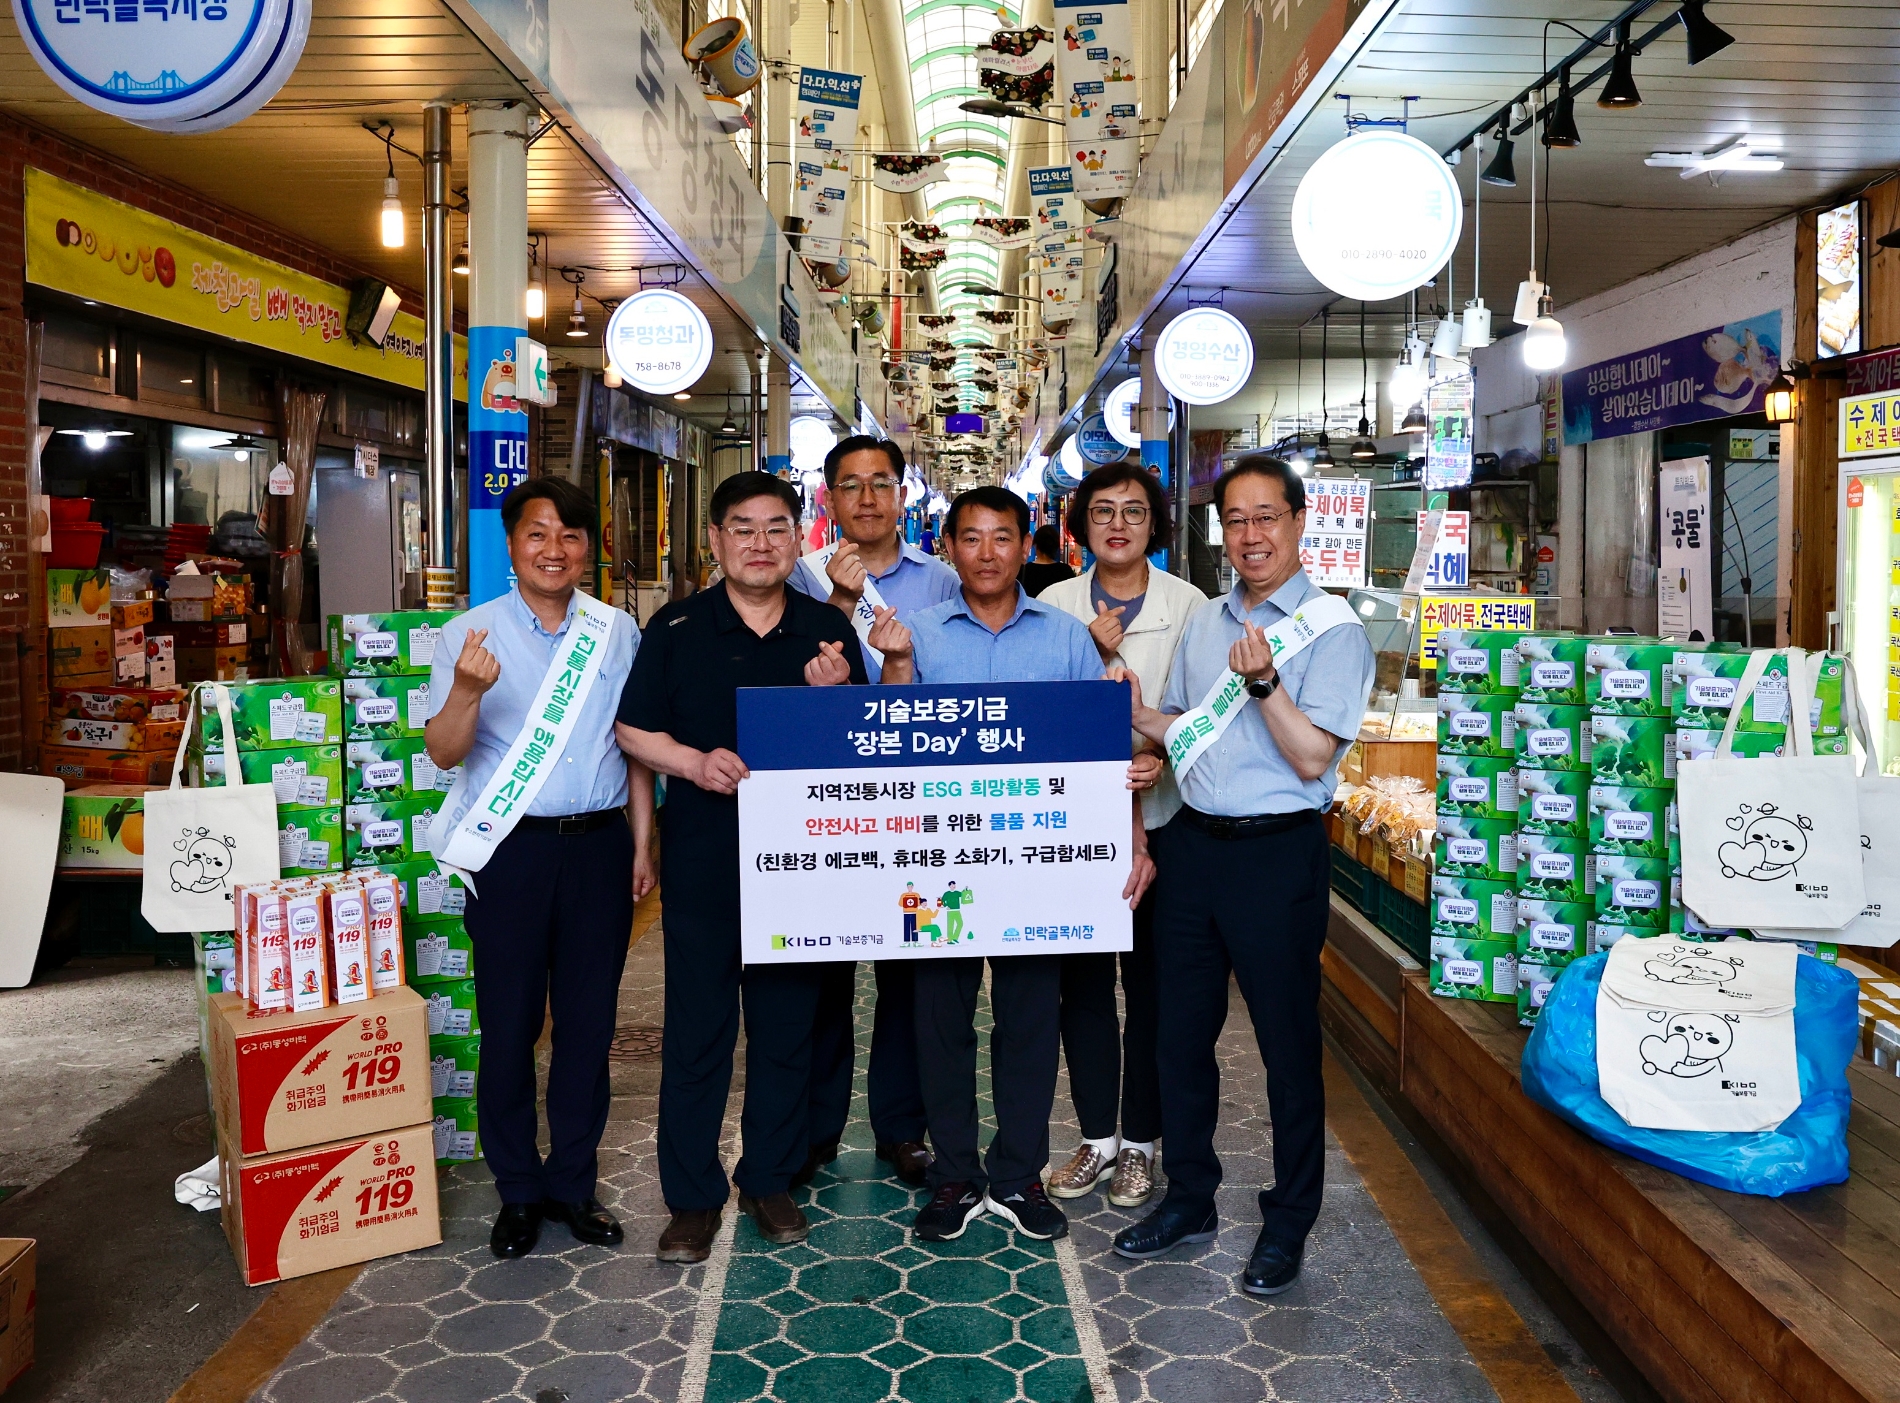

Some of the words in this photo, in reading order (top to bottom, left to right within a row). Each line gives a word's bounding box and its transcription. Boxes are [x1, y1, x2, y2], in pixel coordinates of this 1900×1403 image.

[1341, 249, 1427, 260] 010-2890-4020
[619, 325, 695, 346] 동명청과
[1172, 341, 1241, 361] 경영수산
[635, 361, 682, 372] 758-8678
[484, 473, 509, 488] 2.0
[1325, 537, 1342, 549] 갈아
[1346, 538, 1363, 550] 만든
[542, 632, 597, 726] 전통시장을
[863, 696, 1009, 724] 기술보증기금
[847, 730, 902, 756] ‘장본
[912, 726, 968, 755] Day’
[976, 726, 1026, 752] 행사
[486, 726, 556, 818] 애용합시다
[807, 780, 916, 802] 지역전통시장
[922, 780, 962, 798] ESG
[969, 777, 1042, 797] 희망활동
[1048, 776, 1066, 795] 및
[78, 814, 104, 842] 배
[805, 816, 879, 836] 안전사고
[886, 814, 940, 835] 대비를
[947, 813, 983, 833] 위한
[989, 811, 1025, 831] 물품
[1032, 810, 1068, 830] 지원
[81, 846, 100, 855] 15kg
[755, 851, 818, 873] (친환경
[825, 849, 885, 871] 에코백,
[892, 847, 947, 868] 휴대용
[953, 846, 1015, 867] 소화기,
[1020, 842, 1118, 866] 구급함세트)
[369, 917, 393, 931] 119
[1024, 924, 1095, 942] 민락골목시장
[293, 937, 317, 951] 119
[337, 930, 360, 943] 119
[836, 933, 884, 946] 기술보증기금
[347, 1050, 373, 1061] WORLD
[374, 1041, 403, 1057] PRO
[342, 1055, 401, 1091] 119
[285, 1083, 326, 1101] 취급주의
[286, 1096, 327, 1112] 화기엄금
[360, 1174, 386, 1186] WORLD
[386, 1165, 416, 1181] PRO
[355, 1179, 414, 1216] 119
[298, 1209, 339, 1227] 취급주의
[299, 1222, 340, 1240] 화기엄금
